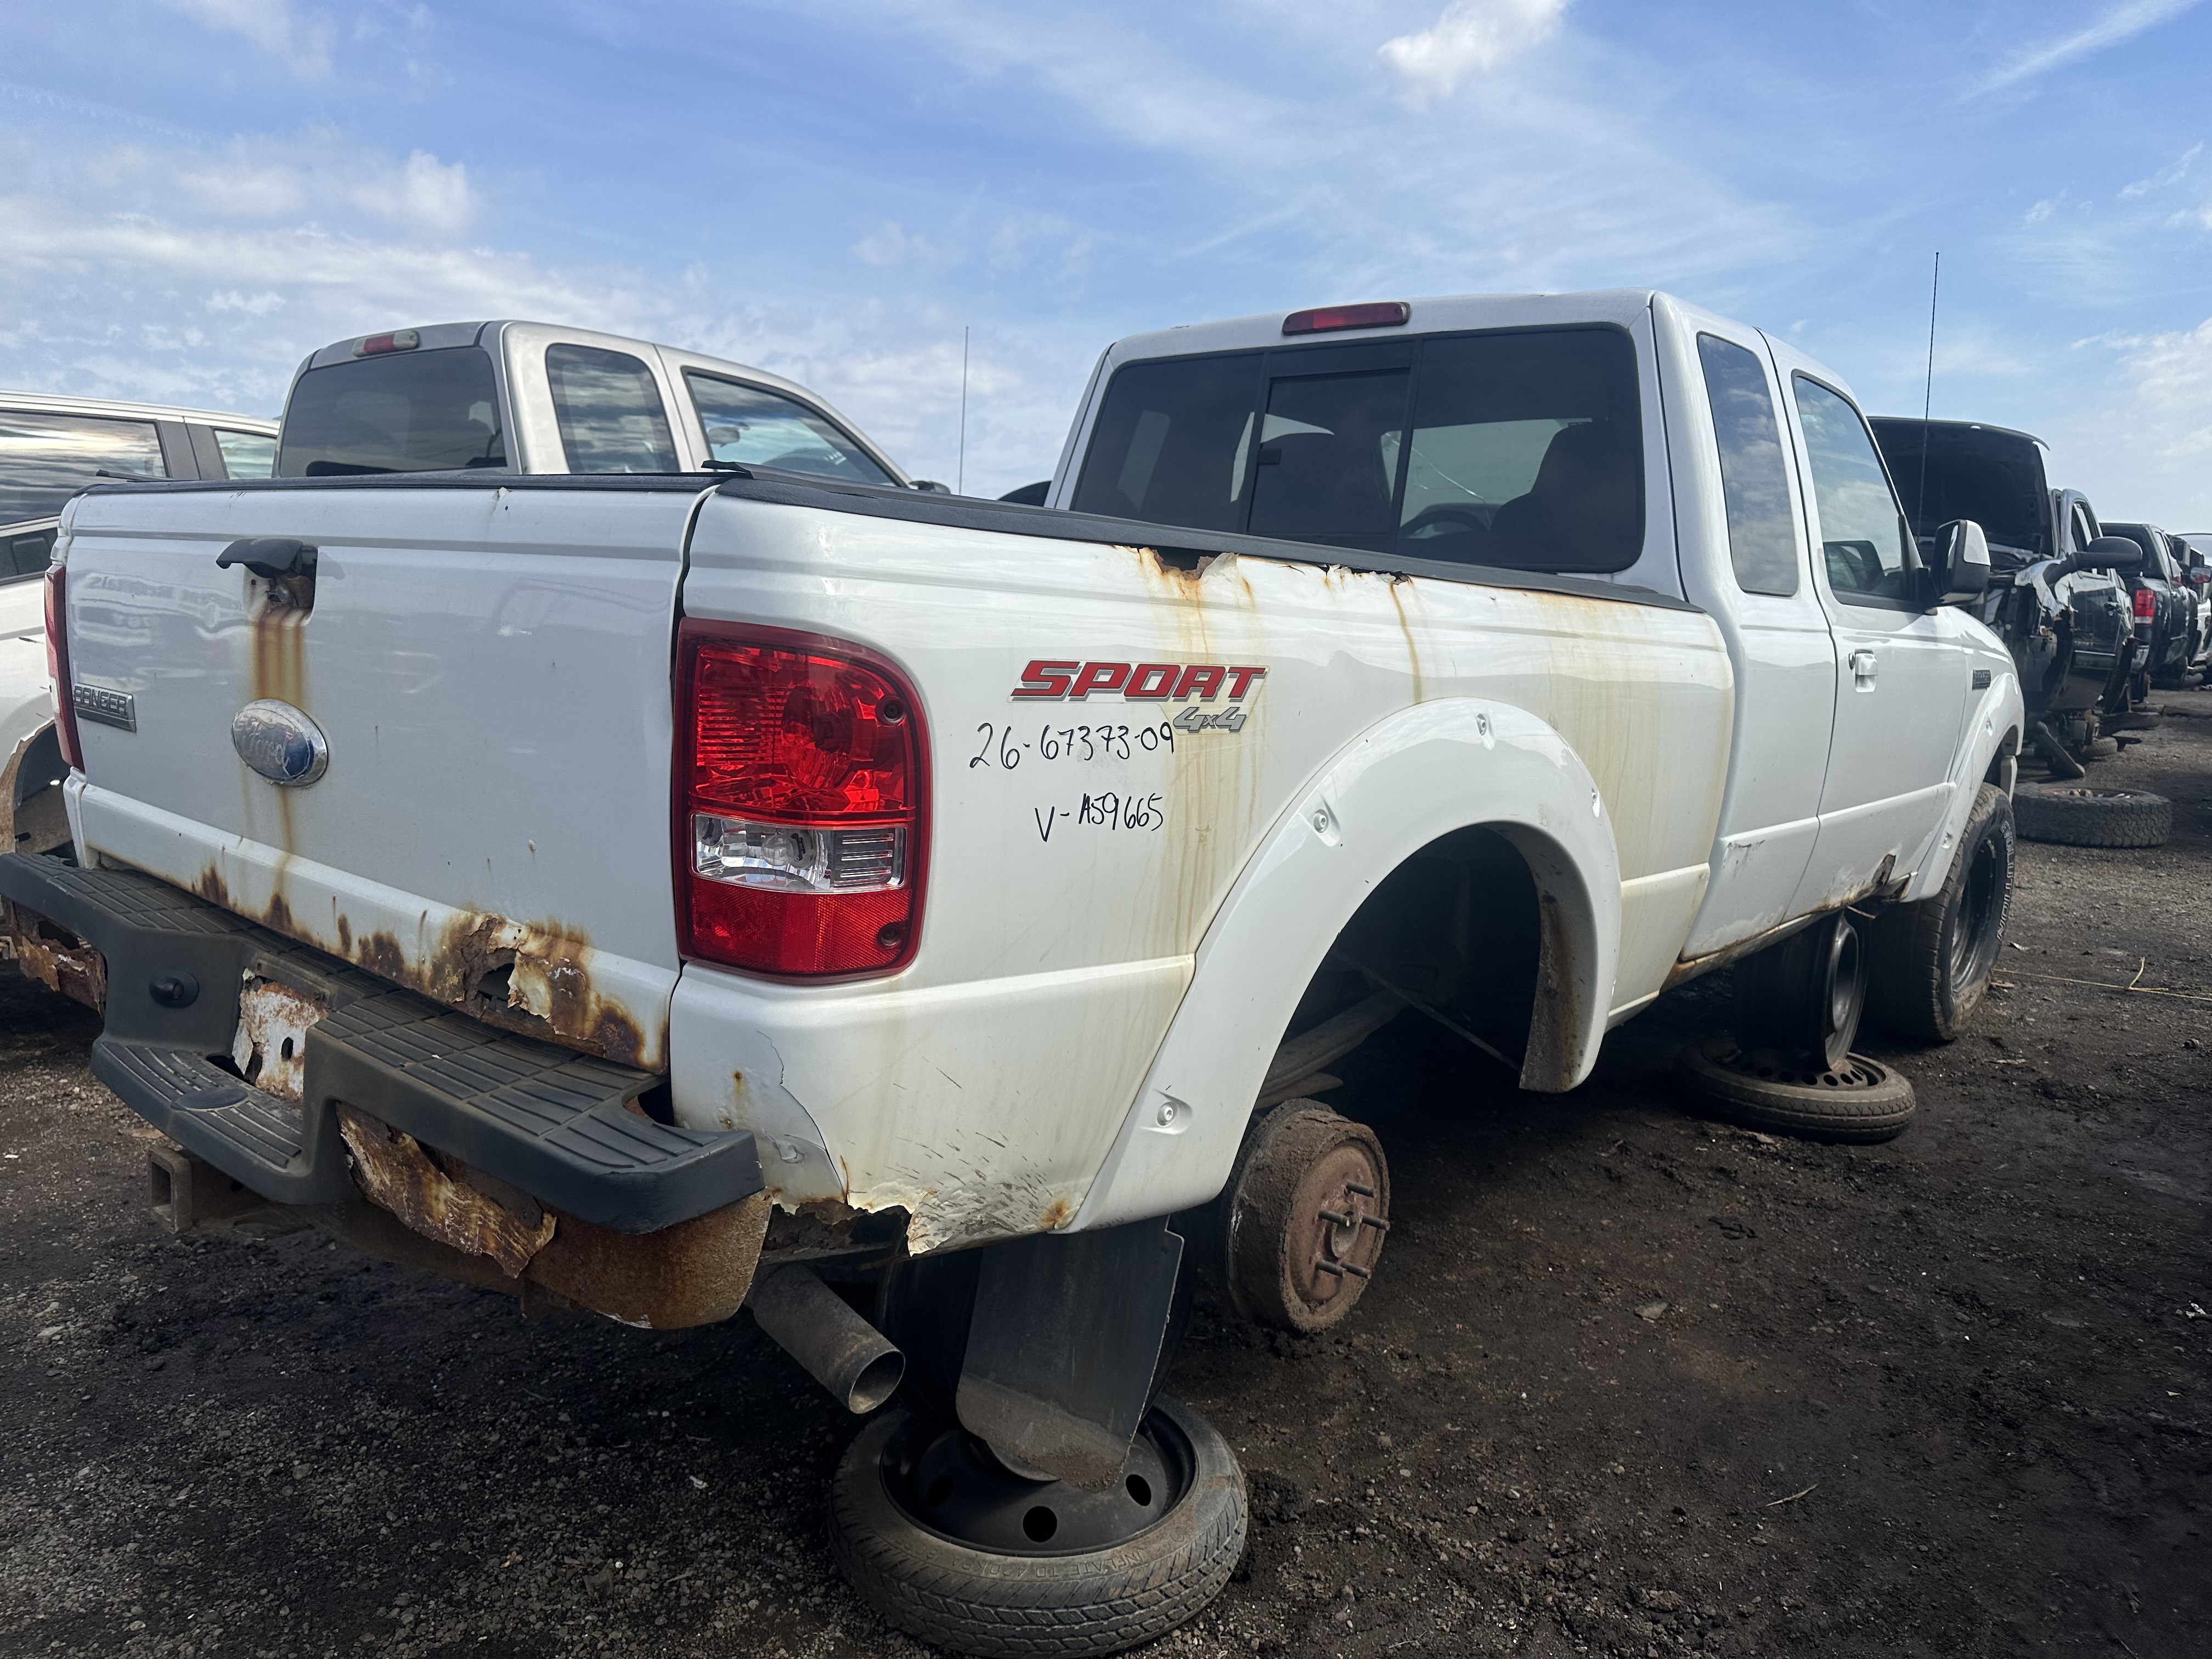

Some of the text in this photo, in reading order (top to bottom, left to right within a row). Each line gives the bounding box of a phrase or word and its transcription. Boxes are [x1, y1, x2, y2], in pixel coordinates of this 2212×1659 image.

[1011, 660, 1266, 702] SPORT
[74, 685, 127, 716] RANGER
[1173, 707, 1248, 733] 4x4
[235, 715, 294, 768] Ford
[1996, 821, 2014, 942] EVOLUTION
[1034, 1566, 1059, 1578] TO
[1069, 1550, 1144, 1577] INFLATE
